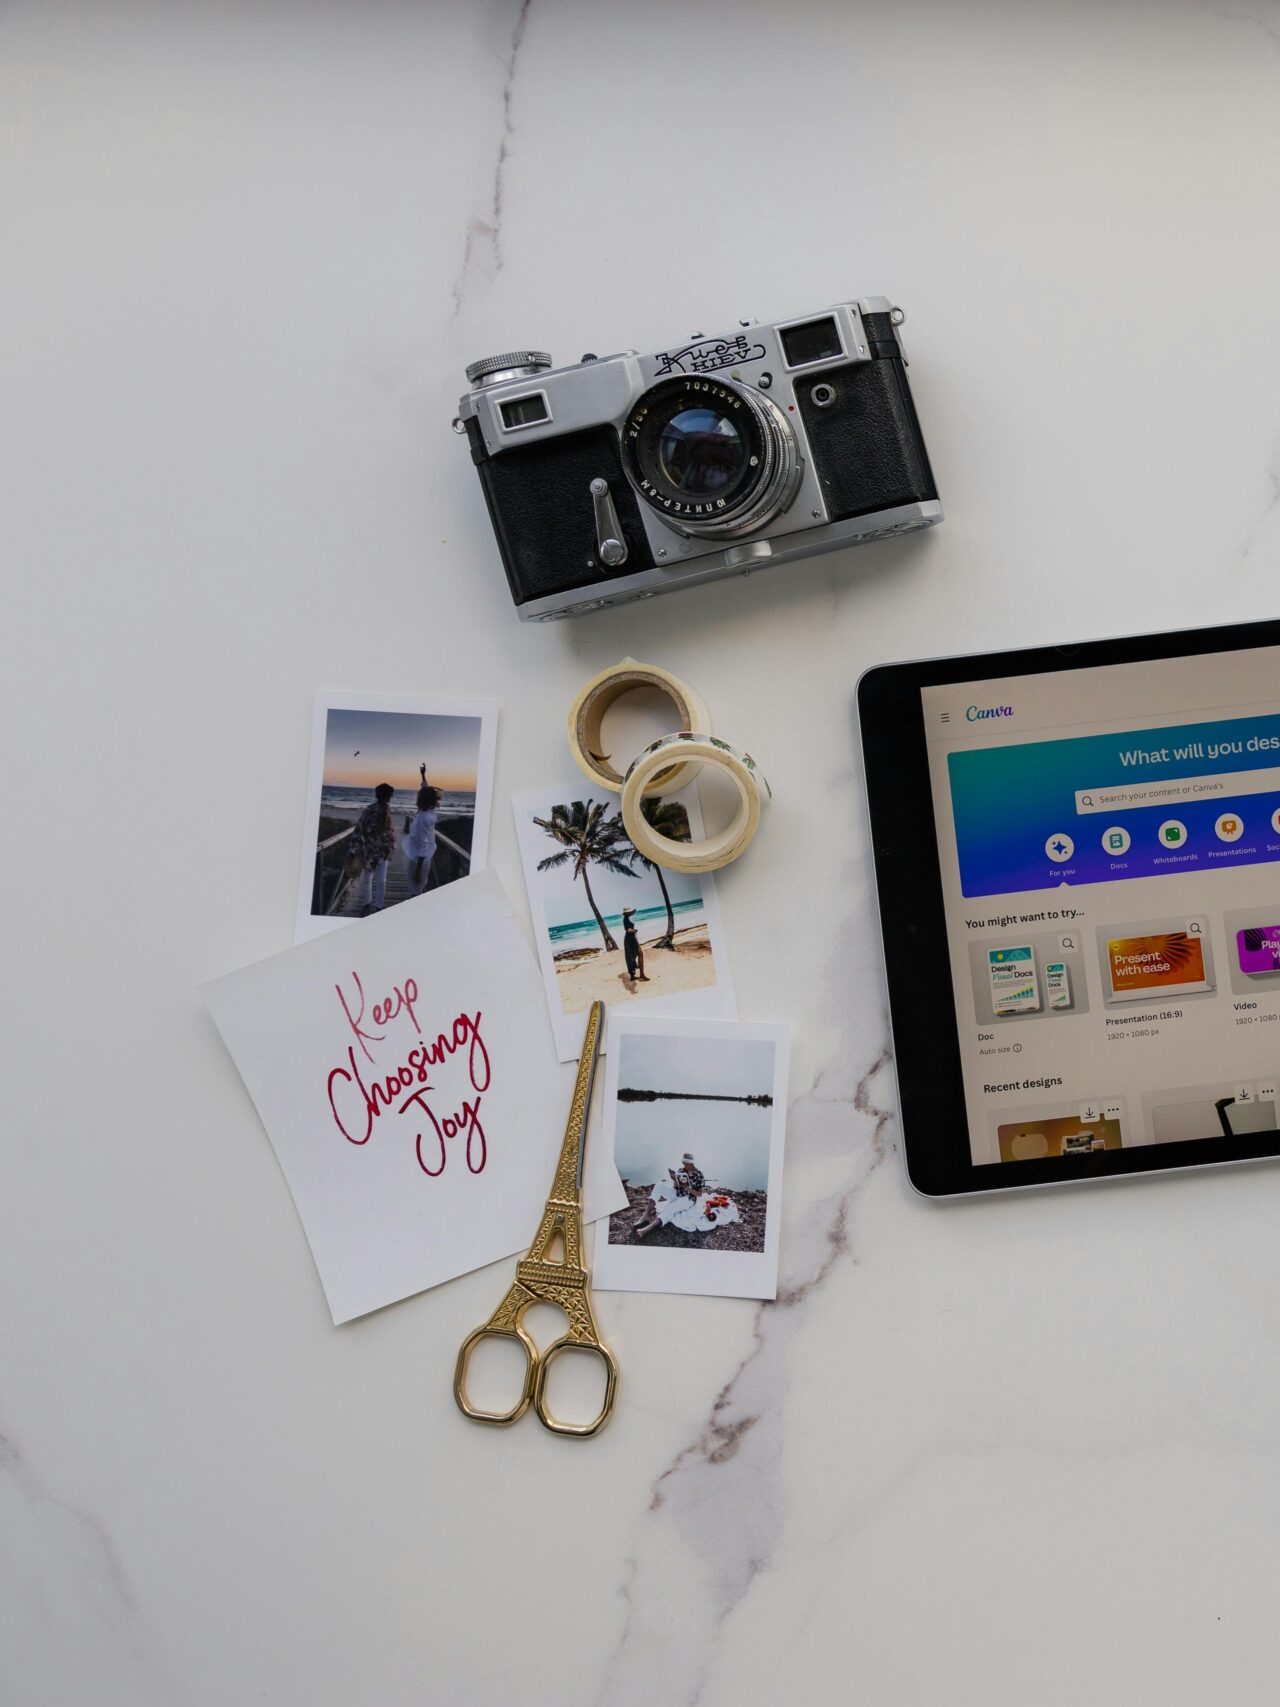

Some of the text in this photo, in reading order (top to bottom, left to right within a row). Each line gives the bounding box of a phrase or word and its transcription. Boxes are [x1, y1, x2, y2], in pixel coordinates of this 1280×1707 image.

[691, 348, 751, 372] KIEV
[684, 381, 741, 409] 7037546
[966, 705, 1014, 722] Canva
[1119, 746, 1170, 767] What
[1174, 742, 1204, 761] will
[1207, 741, 1243, 760] you
[1099, 782, 1224, 803] Search your content or Canva's
[1152, 853, 1198, 865] Whiteboards
[1208, 846, 1257, 859] Presentations
[1063, 869, 1076, 877] you
[965, 907, 1085, 929] You might want to try...
[1114, 951, 1162, 965] Present
[991, 964, 1016, 974] Design
[1014, 970, 1033, 978] Docs
[1115, 962, 1171, 976] with ease
[1233, 1001, 1257, 1010] Video
[335, 971, 422, 1065] Keep
[1105, 1010, 1183, 1026] Presentation (16:9)
[1235, 1016, 1252, 1025] 1920
[1259, 1014, 1277, 1022] 1080
[977, 1033, 994, 1041] Doc
[1107, 1032, 1125, 1040] 1920
[1131, 1029, 1149, 1038] 1080
[979, 1046, 1011, 1055] Auto size
[328, 1011, 491, 1145] Choosing
[983, 1077, 1063, 1093] Recent designs
[398, 1086, 487, 1177] Joy
